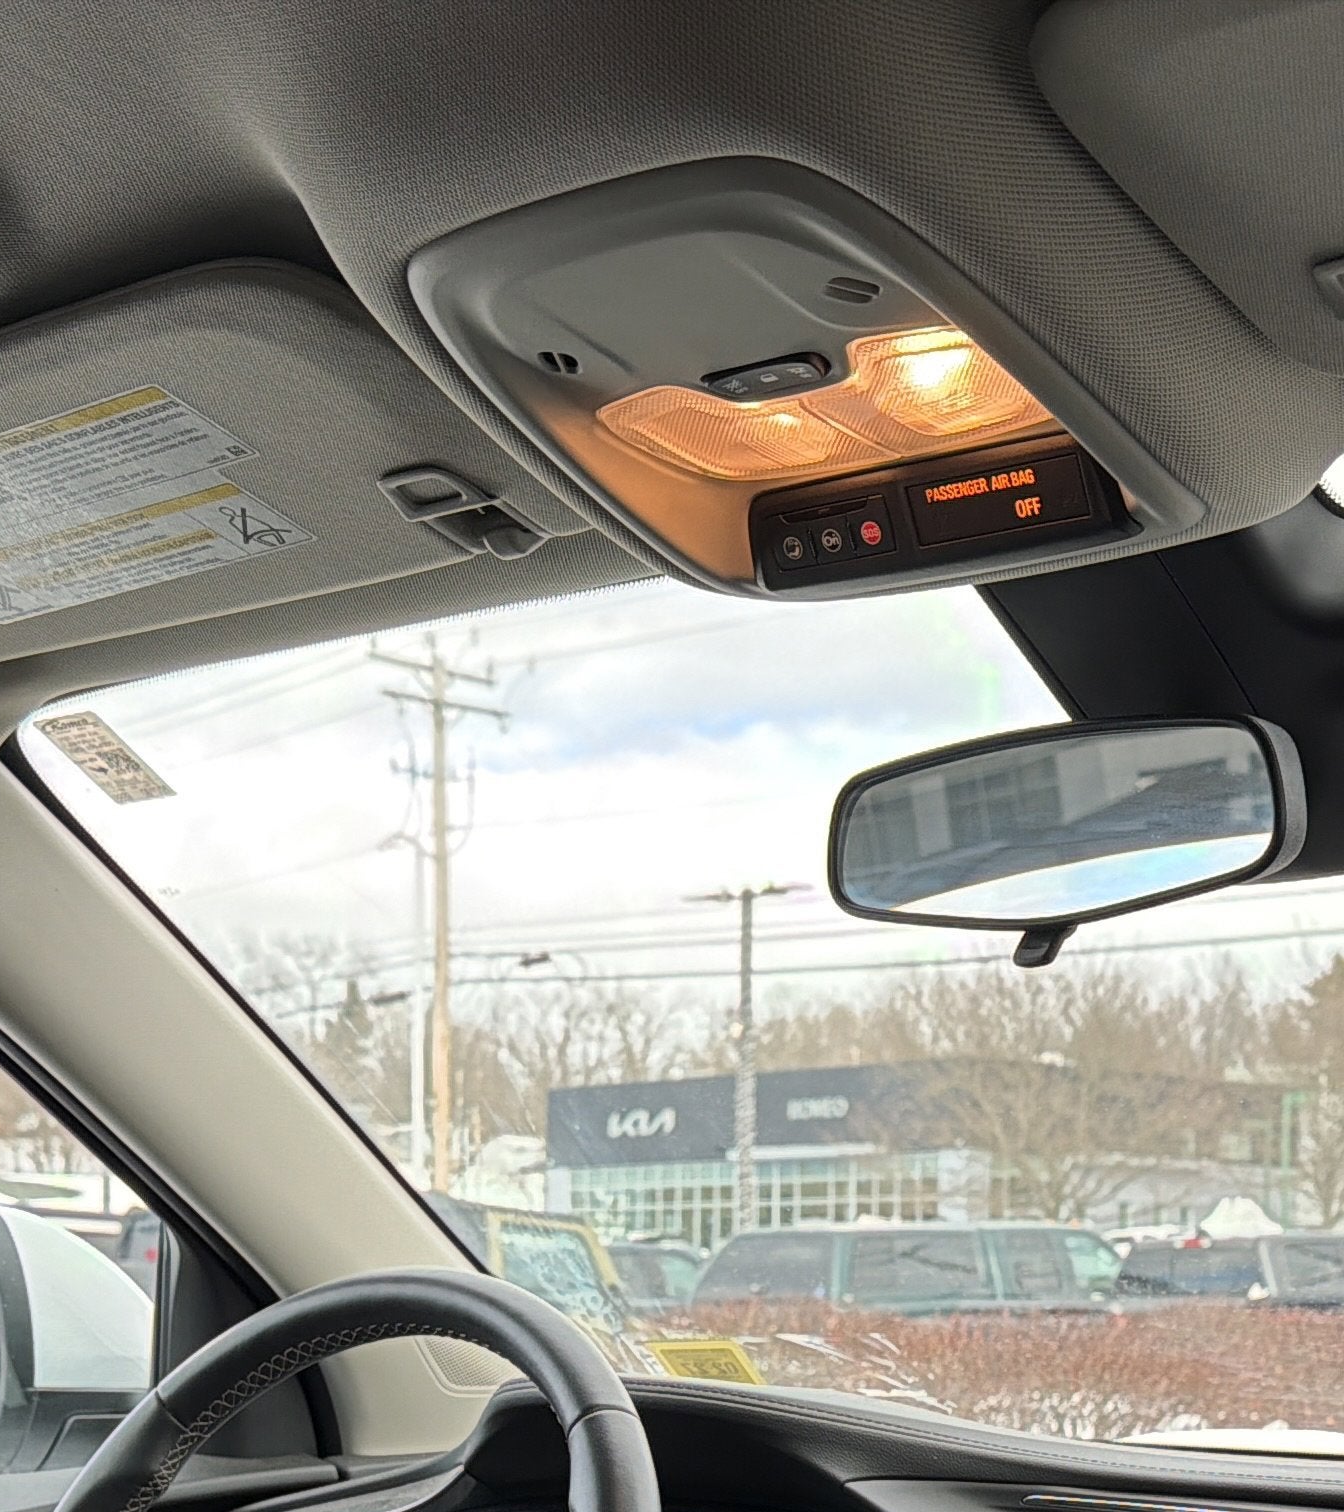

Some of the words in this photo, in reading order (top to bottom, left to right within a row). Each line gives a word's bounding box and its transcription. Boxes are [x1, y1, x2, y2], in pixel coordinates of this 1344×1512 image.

[925, 475, 989, 503] PASSENGER
[990, 472, 1010, 493] AIR
[1010, 468, 1035, 487] BAG
[1014, 497, 1042, 520] OFF
[862, 524, 882, 541] SOS
